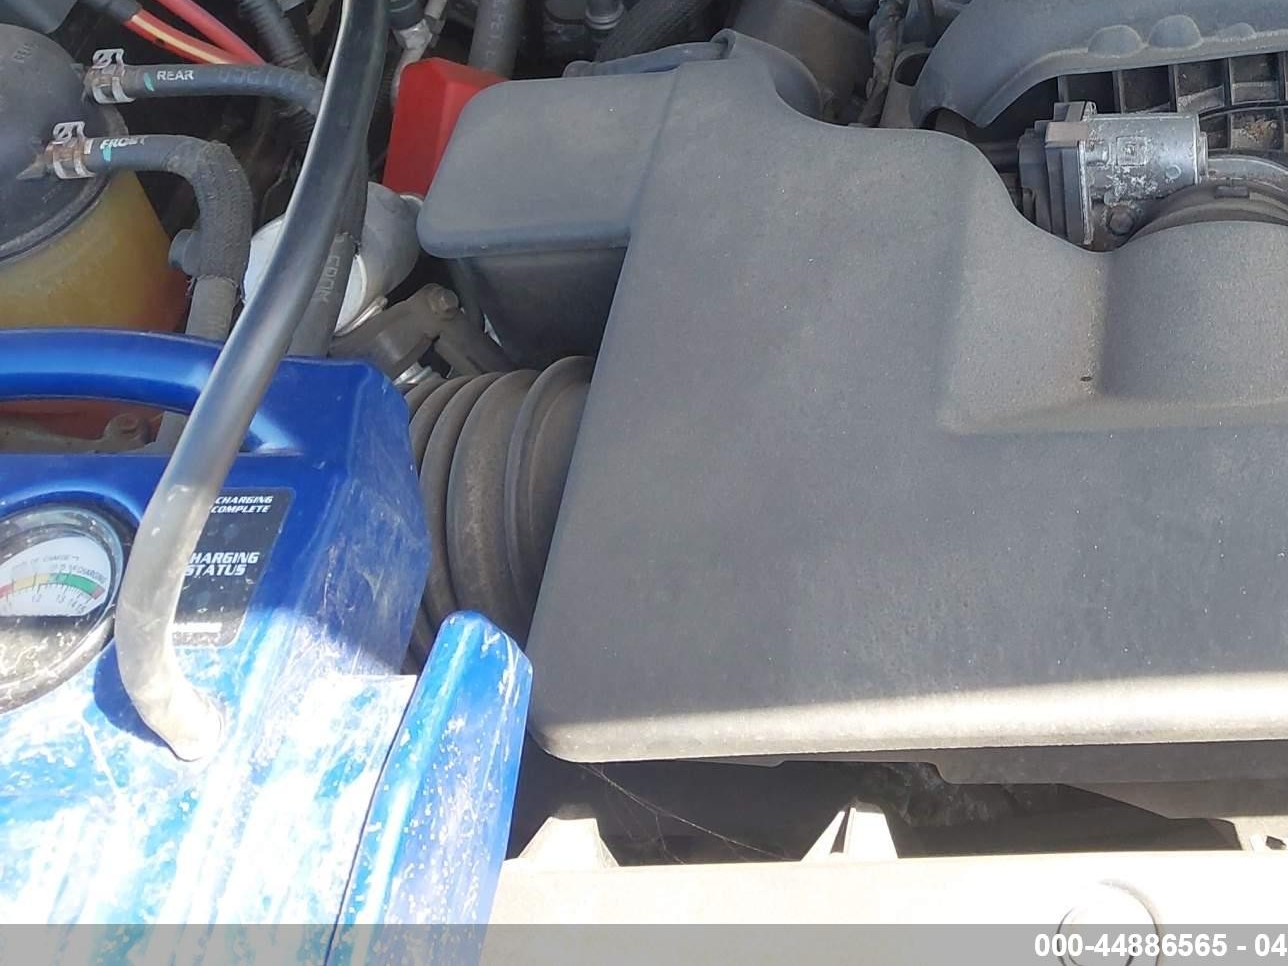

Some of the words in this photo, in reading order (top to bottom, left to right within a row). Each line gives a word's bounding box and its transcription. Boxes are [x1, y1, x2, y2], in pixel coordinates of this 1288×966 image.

[156, 69, 195, 81] REAR
[215, 495, 274, 505] CHARGING
[211, 504, 272, 514] COMPLETE
[190, 552, 261, 565] HARGING
[184, 564, 248, 577] STATUS
